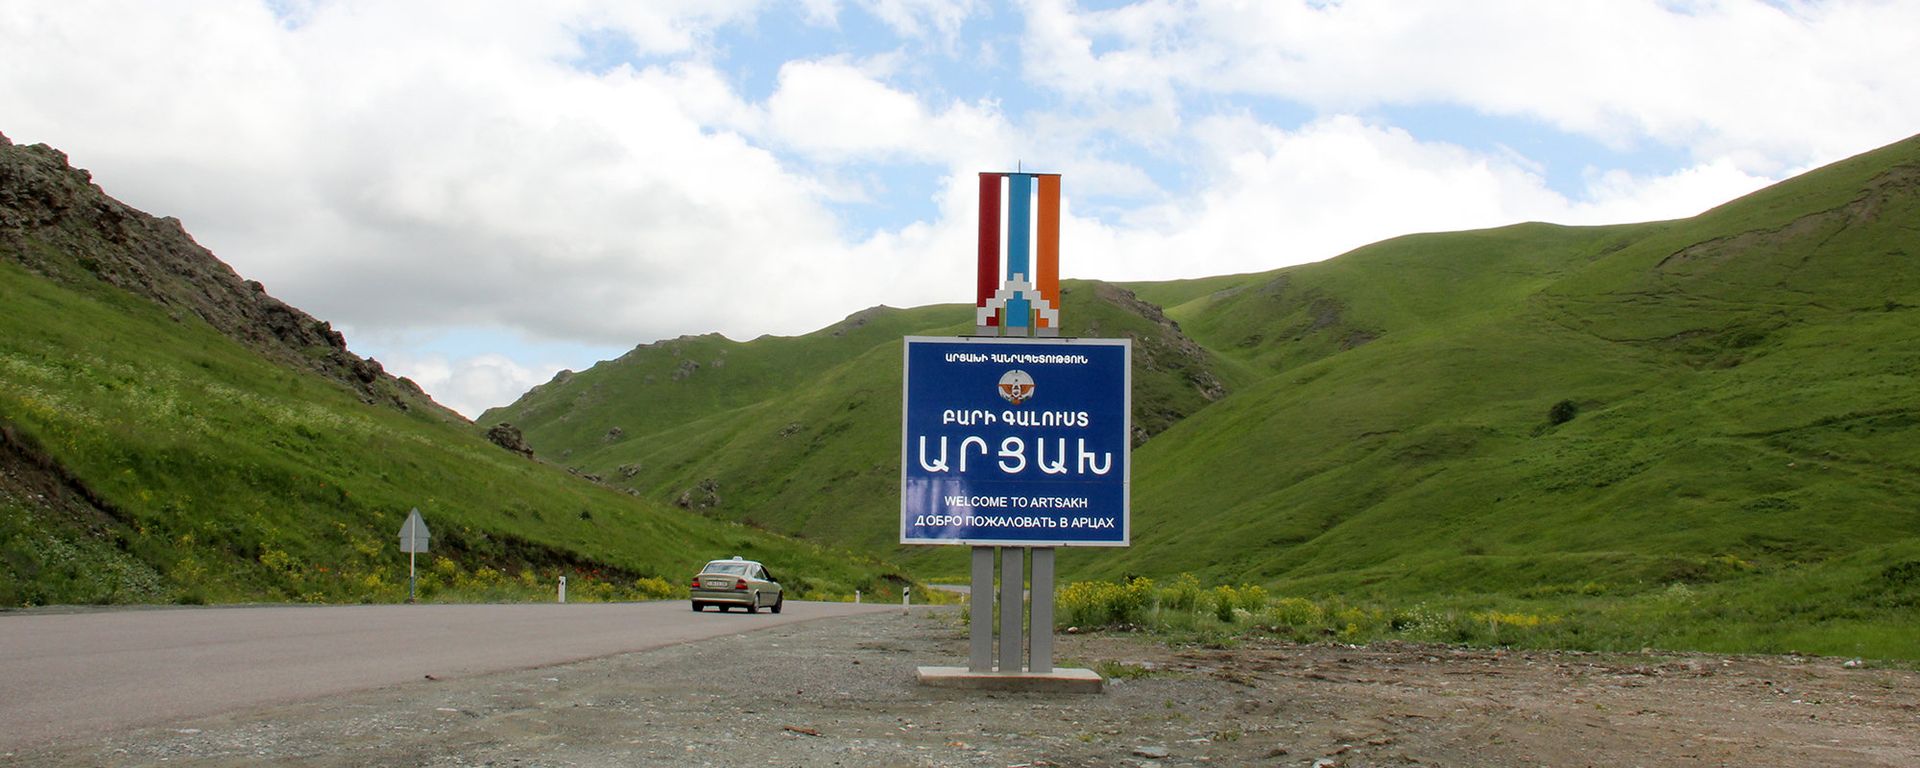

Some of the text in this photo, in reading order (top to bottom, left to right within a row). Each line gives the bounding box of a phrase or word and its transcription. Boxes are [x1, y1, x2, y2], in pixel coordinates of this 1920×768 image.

[945, 353, 988, 363] ԱՐՑԱԽԻ
[943, 409, 1089, 427] ԲԱՐԻ ԳԱԼՈՒՍՏ
[919, 435, 1111, 475] ԱՐՑԱԽ
[944, 496, 1088, 508] WELCOME TO ARTSAKH
[914, 515, 1115, 529] ДОБРО ПОЖАЛОВАТЬ В АРЦАХ
